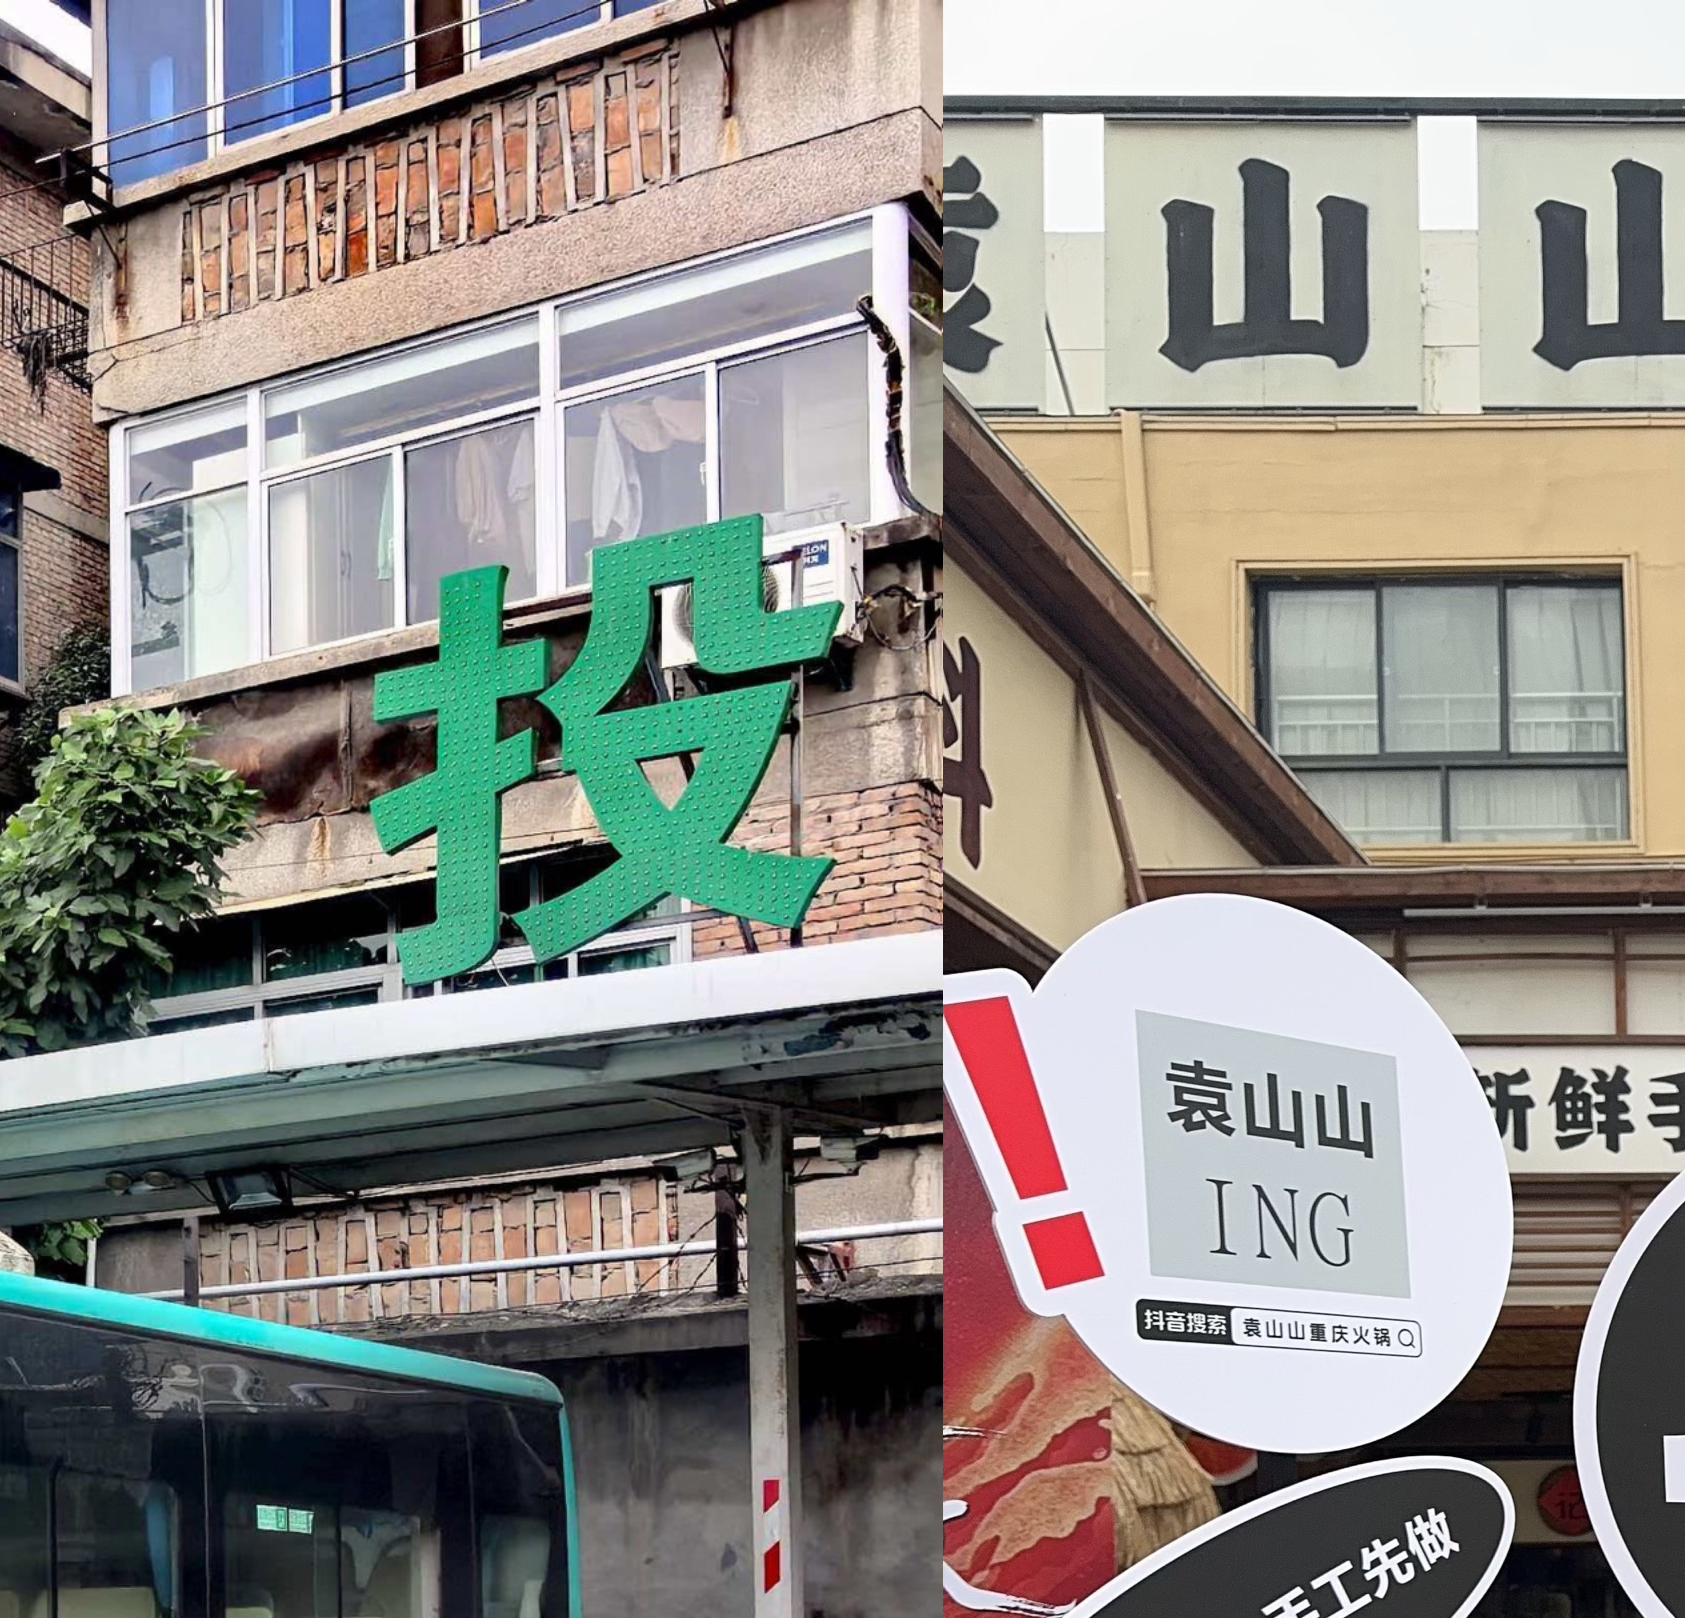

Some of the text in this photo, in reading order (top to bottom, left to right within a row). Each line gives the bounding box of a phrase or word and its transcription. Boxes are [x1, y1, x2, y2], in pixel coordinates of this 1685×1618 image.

[369, 512, 844, 986] 投
[1164, 1059, 1374, 1160] 袁山山
[1205, 1177, 1355, 1268] ING
[1143, 1307, 1228, 1337] 抖音搜索
[1241, 1316, 1392, 1348] 袁山山重庆火锅
